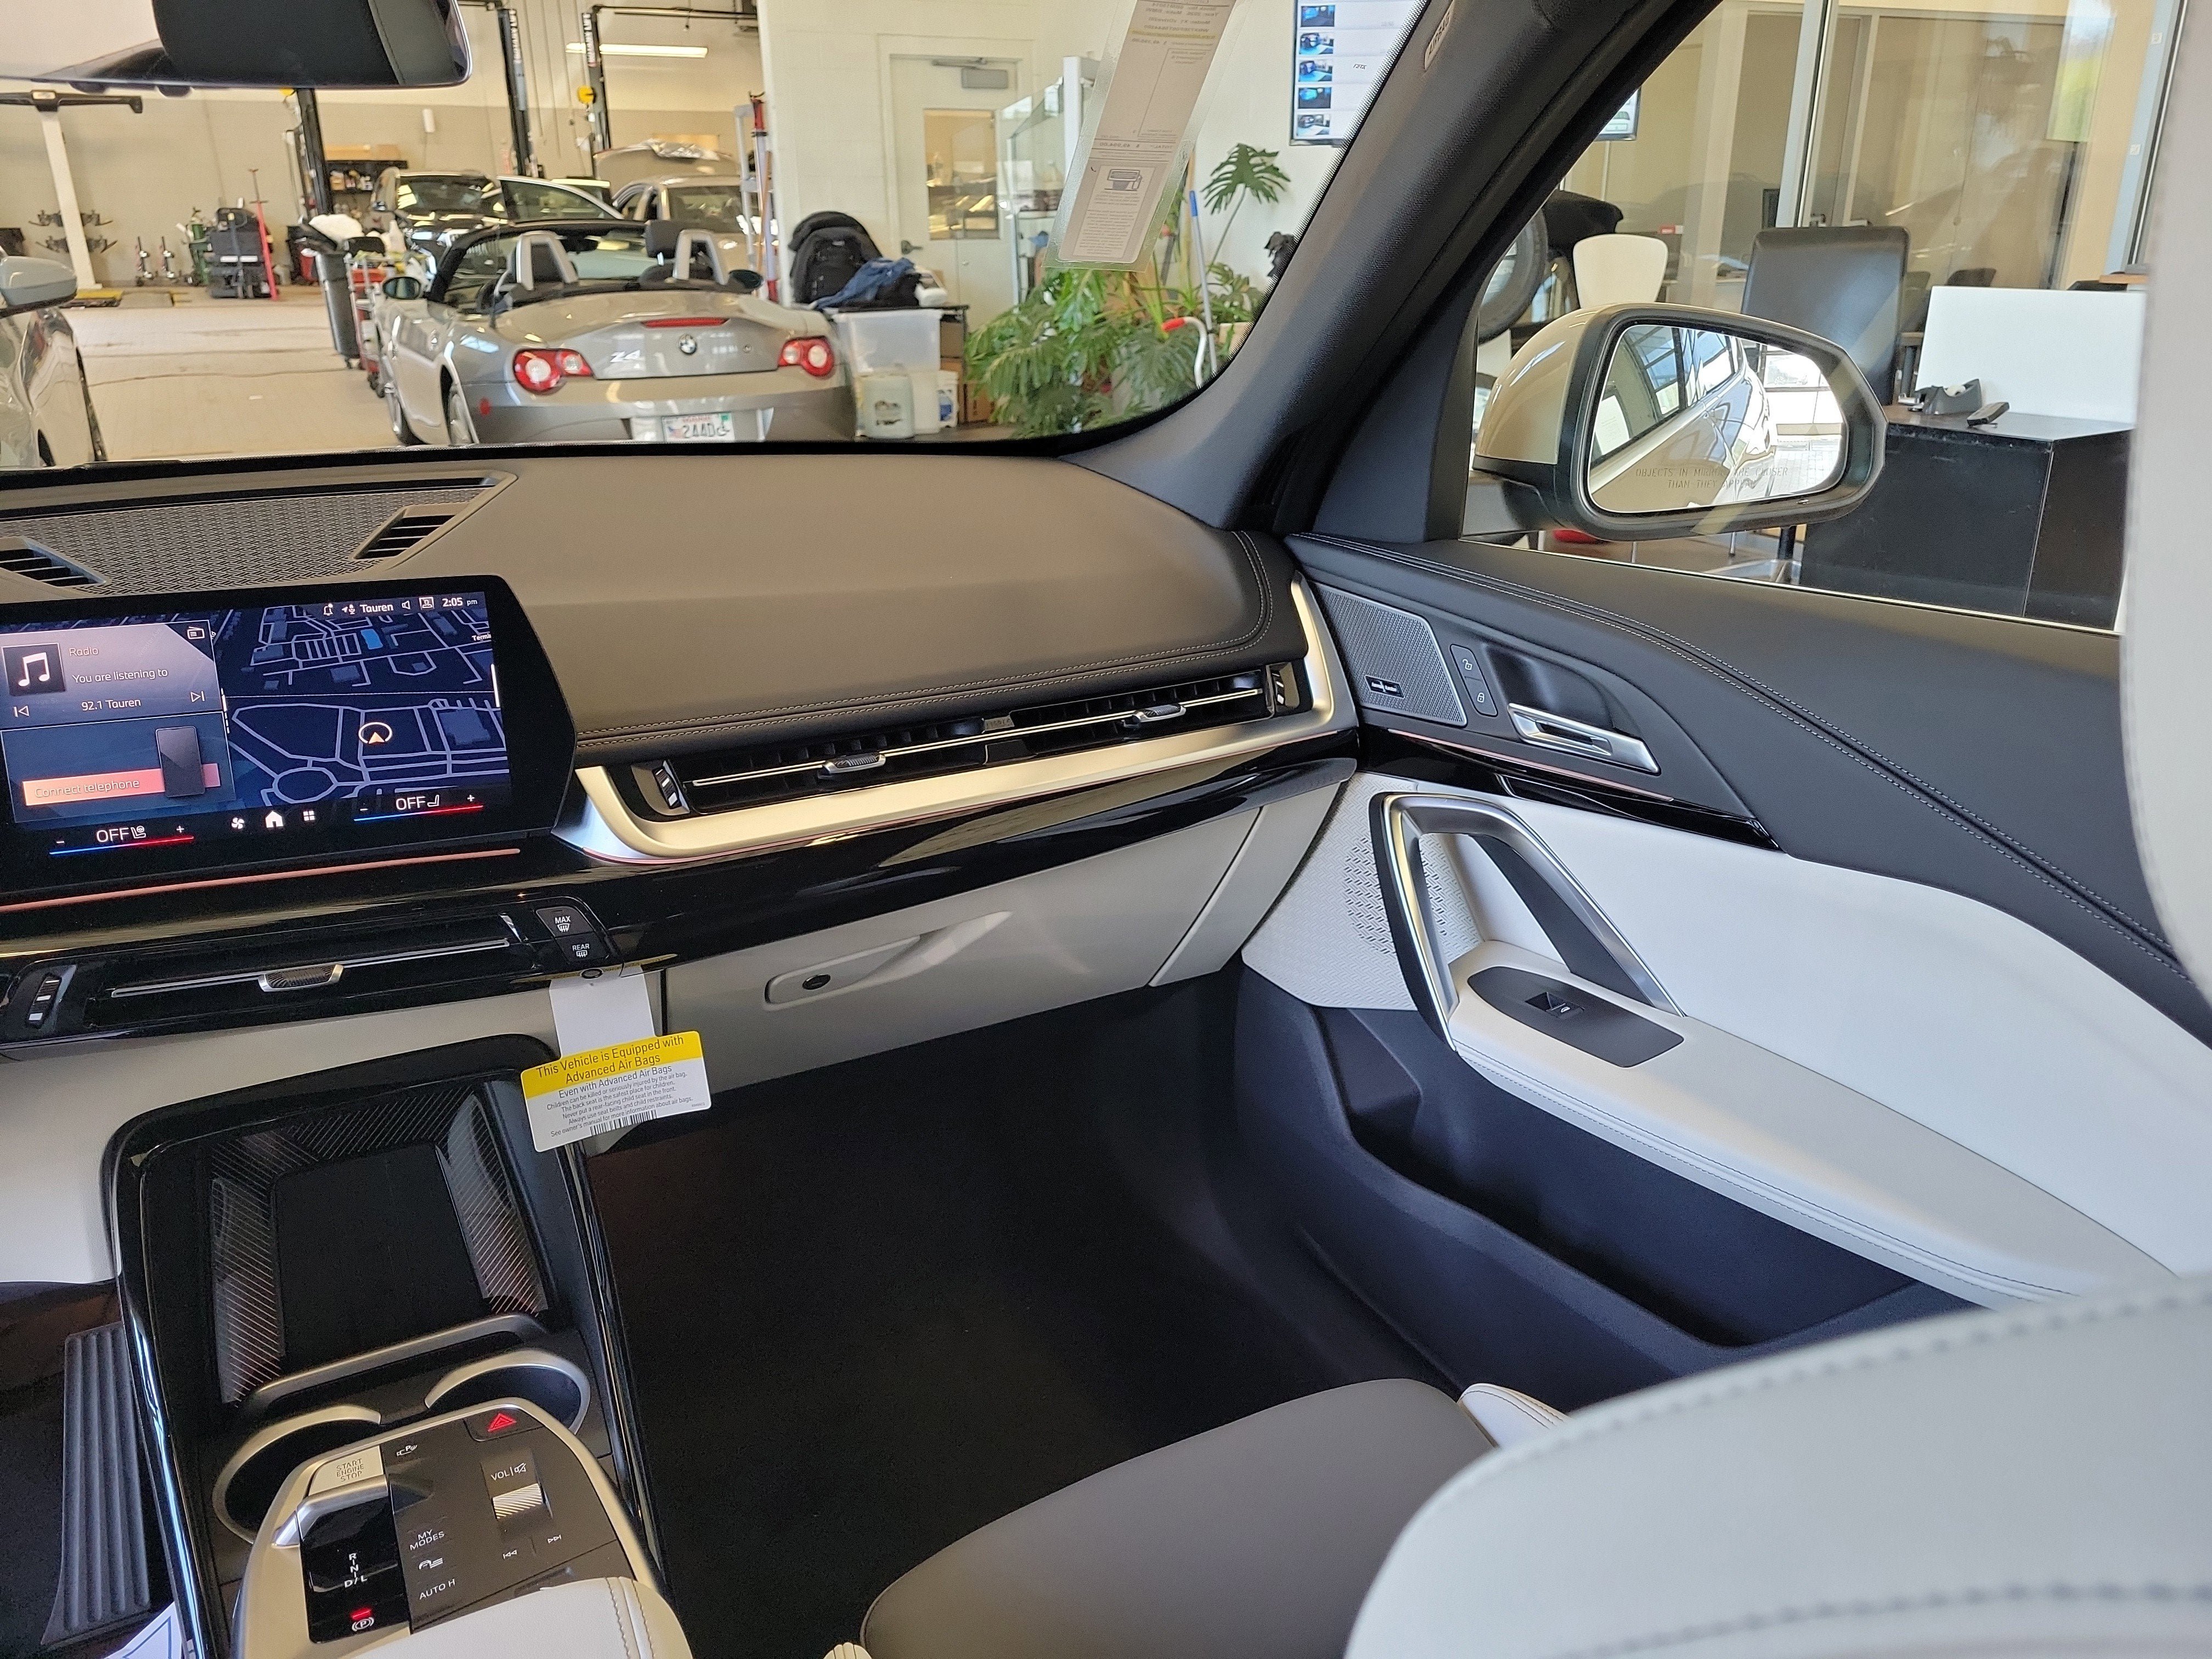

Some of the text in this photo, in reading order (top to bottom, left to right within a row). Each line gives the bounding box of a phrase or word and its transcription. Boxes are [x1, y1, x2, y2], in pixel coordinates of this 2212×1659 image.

[1635, 469, 1673, 477] OBJECTS
[1734, 468, 1749, 476] ARE
[1756, 467, 1788, 476] CLOSER
[1668, 479, 1690, 488] THAN
[1697, 479, 1717, 488] THEY
[360, 602, 394, 614] Tauren
[442, 597, 478, 608] 2:05 pm
[69, 646, 99, 657] Radio
[72, 668, 168, 684] You are listening to
[81, 699, 142, 711] 92.1 Tauren
[35, 779, 140, 798] Connect telephone
[396, 795, 426, 811] OFF
[97, 827, 129, 843] OFF
[555, 915, 571, 924] MAX
[572, 943, 590, 951] REAR
[536, 1035, 684, 1078] This Vehicle is Equipped with
[566, 1054, 661, 1084] Advanced Air Bags
[558, 1065, 672, 1098] Even with Advanced Air Bags
[547, 1099, 569, 1110] Children
[633, 1078, 651, 1087] injured
[630, 1086, 644, 1095] place
[652, 1081, 675, 1089] children.
[622, 1094, 634, 1103] child
[583, 1117, 602, 1127] manual
[625, 1105, 655, 1115] information
[656, 1099, 671, 1108] about
[568, 1116, 586, 1125] Always
[336, 1458, 362, 1471] START
[336, 1464, 364, 1477] ENGINE
[340, 1470, 362, 1482] STOP
[490, 1470, 510, 1481] VOL
[409, 1531, 444, 1551] MODES
[417, 1529, 432, 1541] MY
[350, 1564, 359, 1573] N
[419, 1578, 455, 1600] AUTO H
